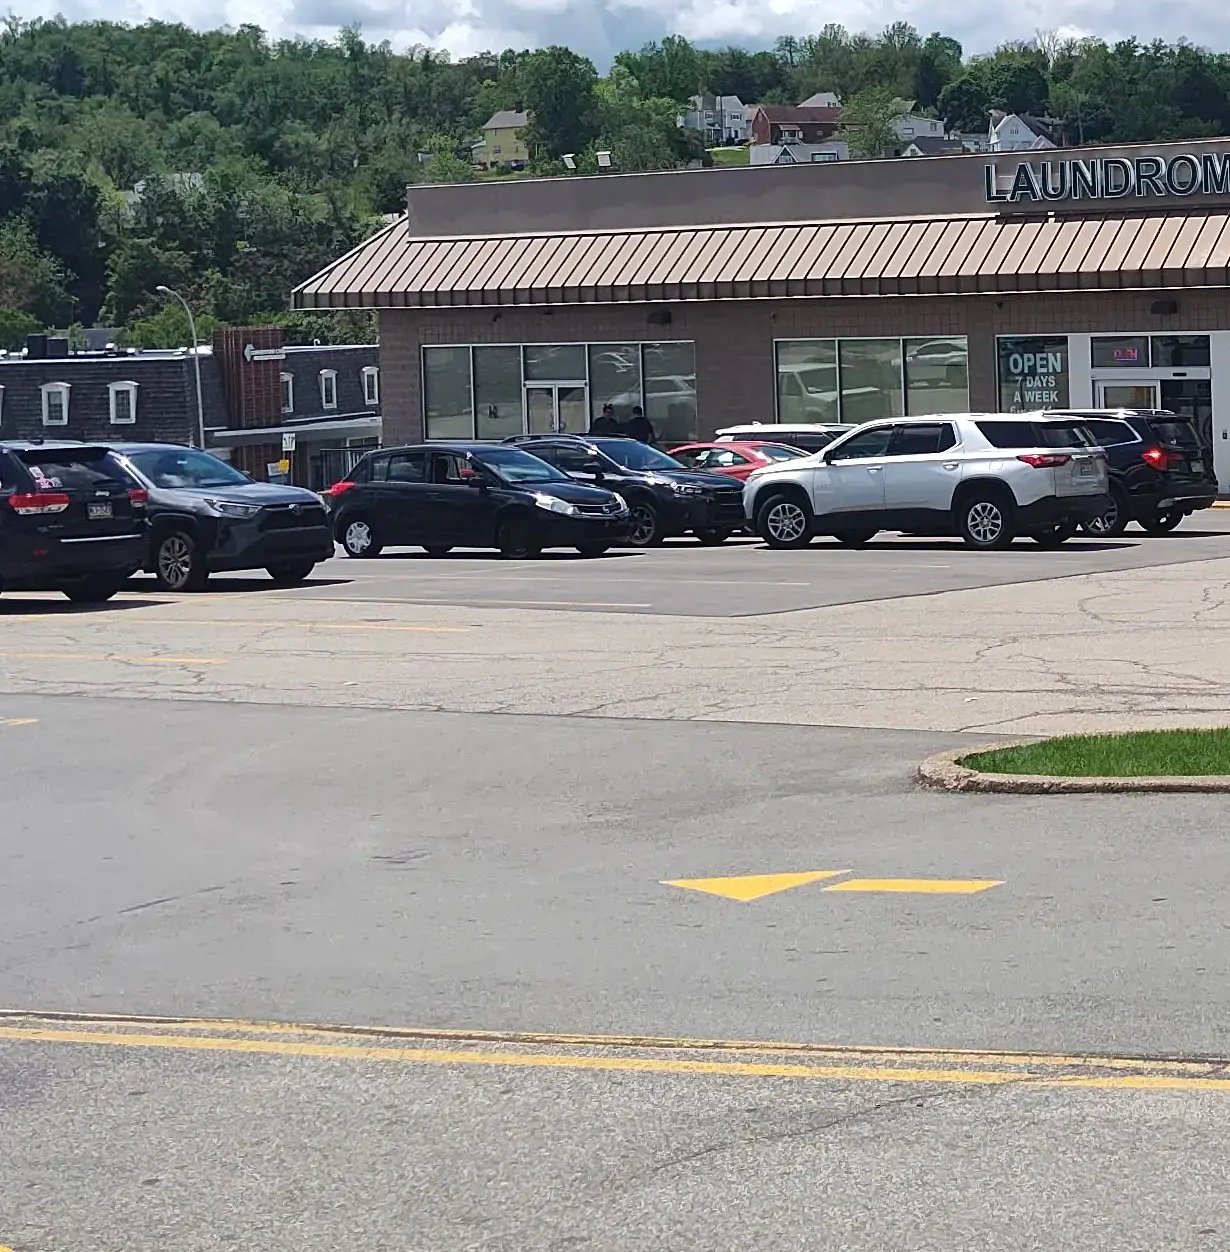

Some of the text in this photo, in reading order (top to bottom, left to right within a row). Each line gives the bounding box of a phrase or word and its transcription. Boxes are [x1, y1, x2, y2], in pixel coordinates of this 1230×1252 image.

[1009, 352, 1062, 374] OPEN
[1015, 375, 1056, 388] 7 DAYS
[1013, 390, 1059, 403] A WEEK
